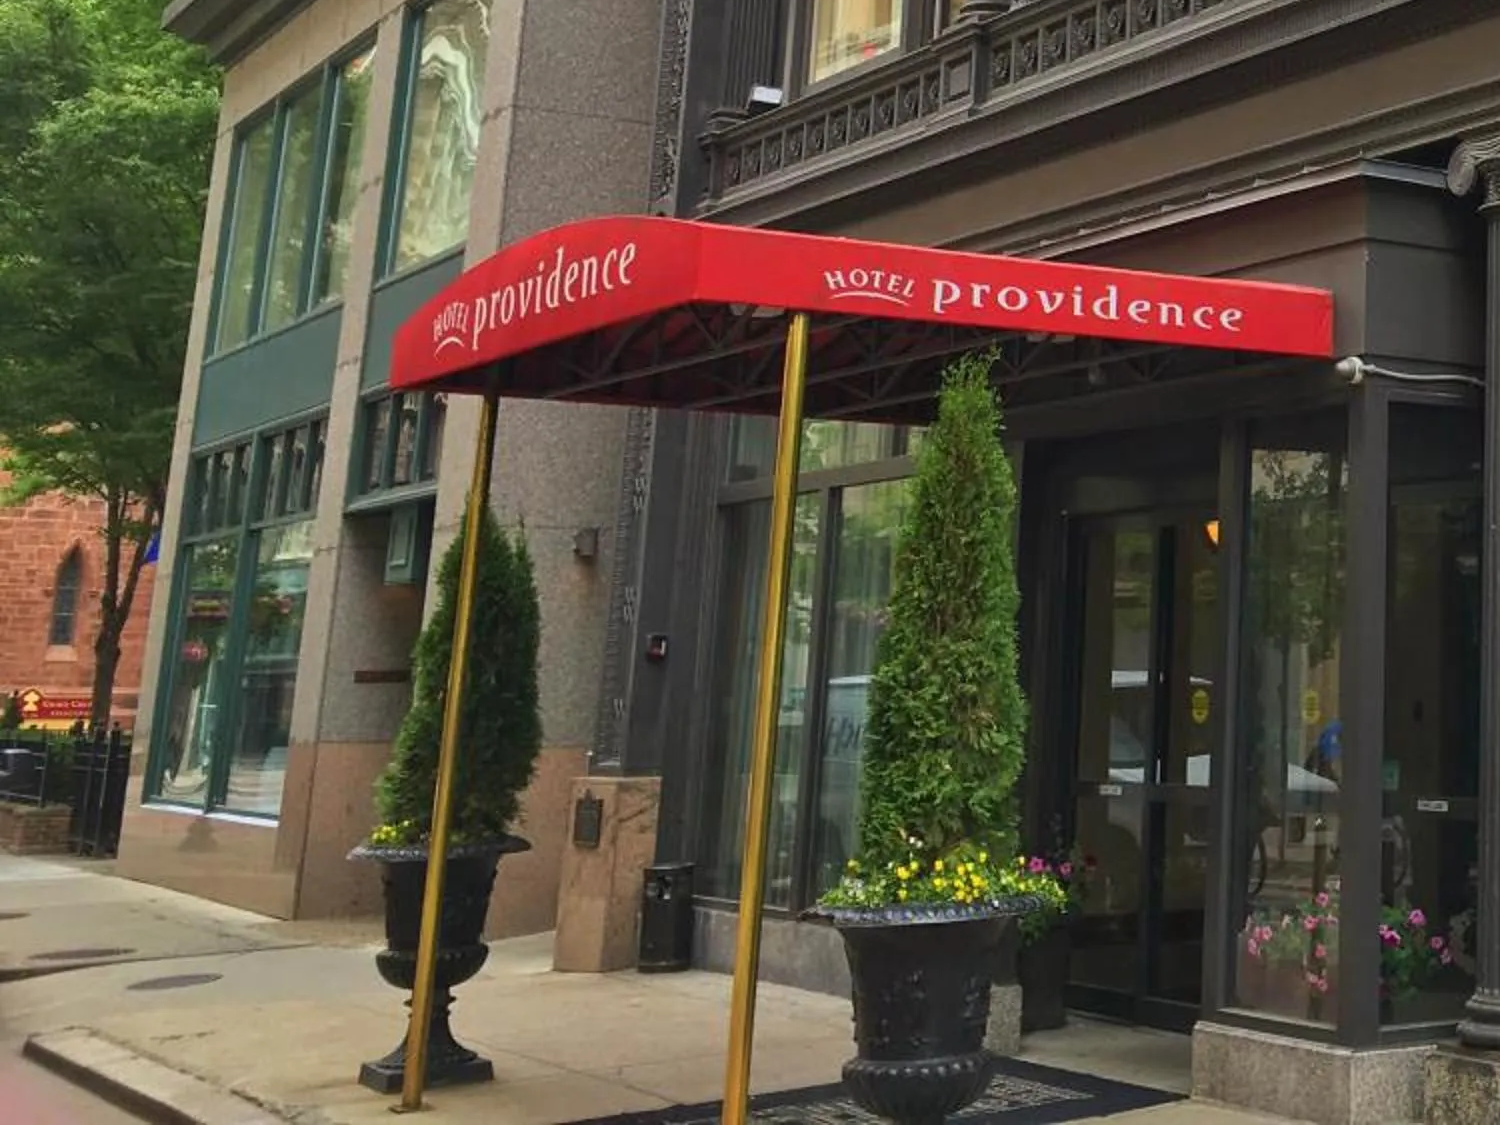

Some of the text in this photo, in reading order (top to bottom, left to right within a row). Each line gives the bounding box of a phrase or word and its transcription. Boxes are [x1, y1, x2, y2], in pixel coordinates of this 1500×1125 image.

[432, 242, 636, 351] HOTEL providence
[823, 267, 1245, 333] HOTEL providence
